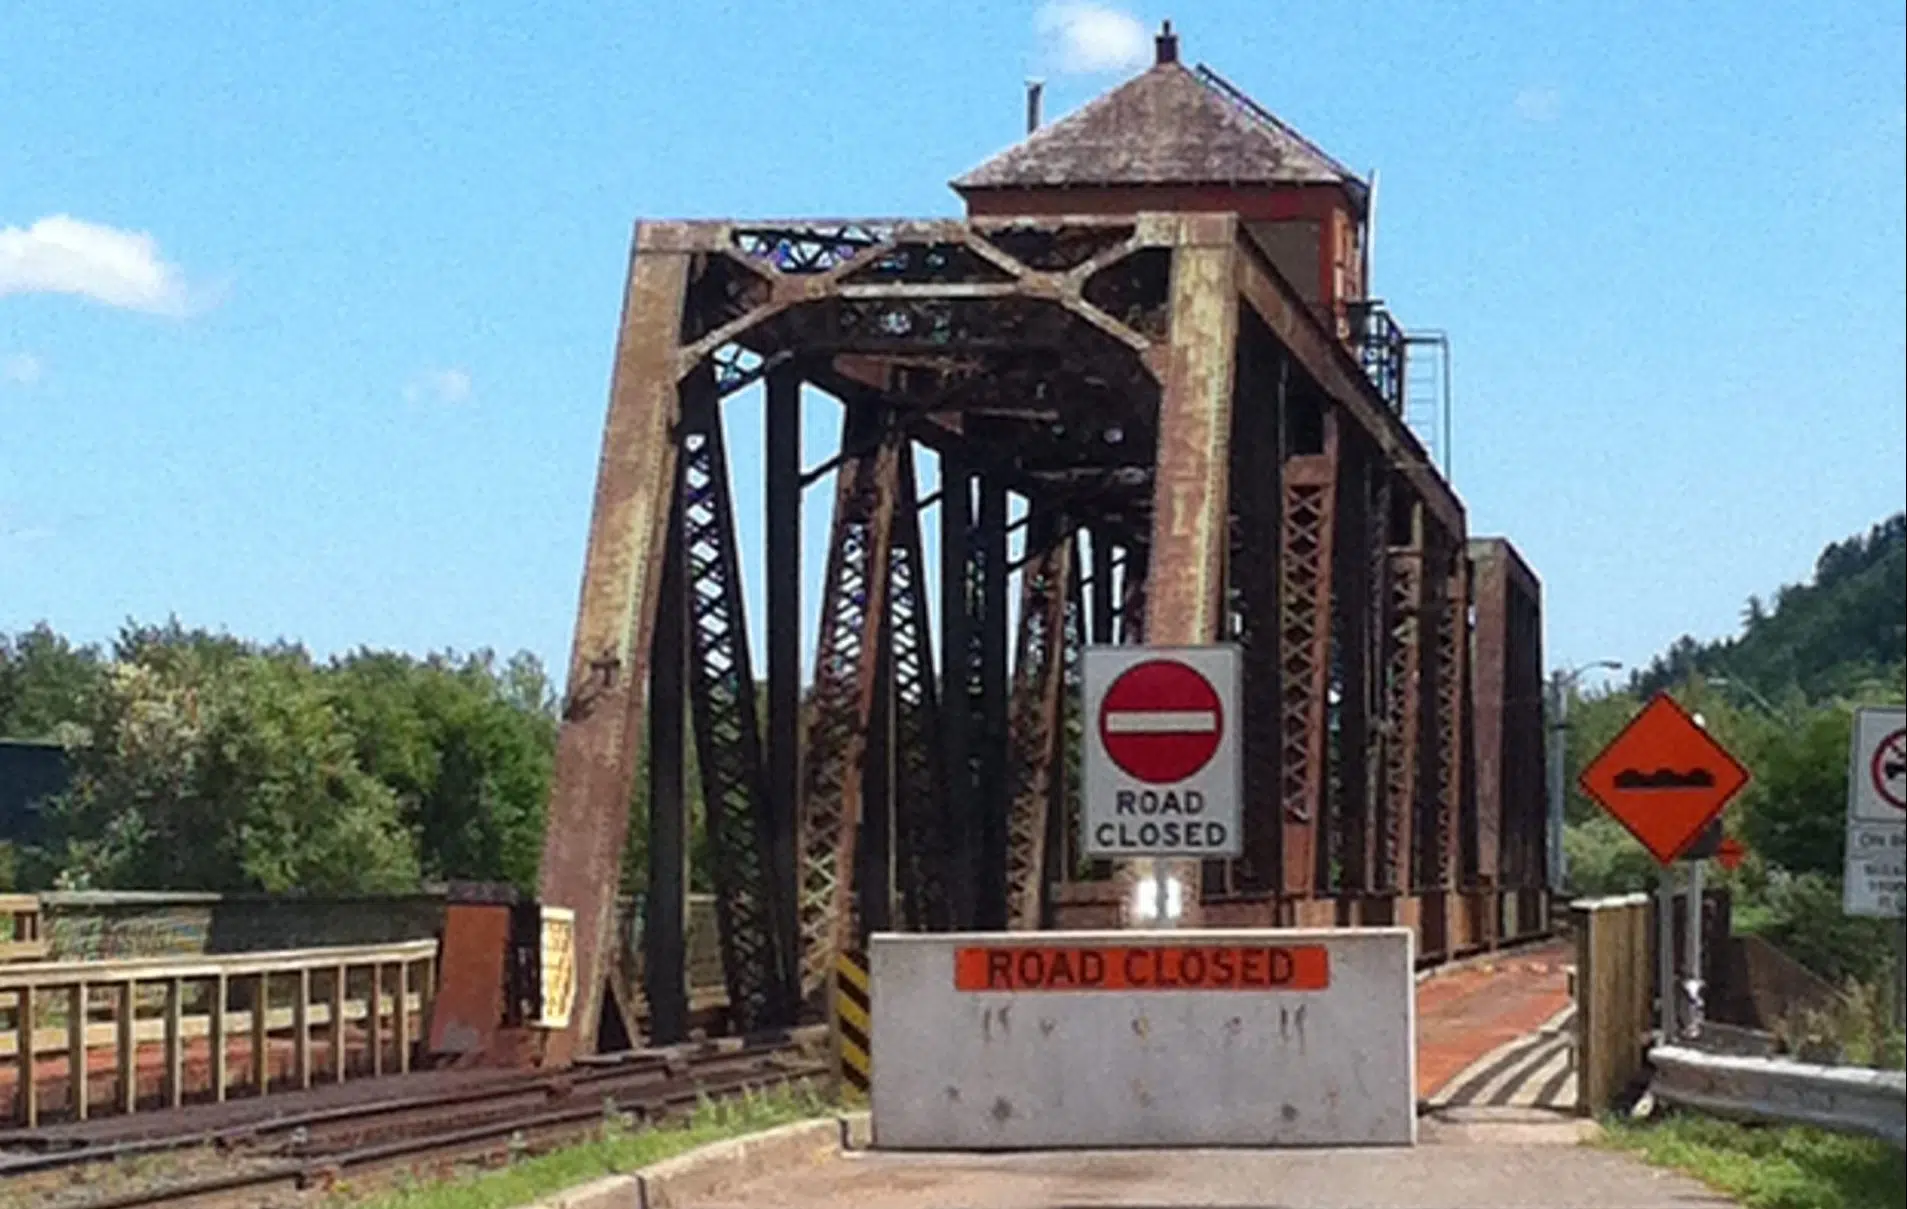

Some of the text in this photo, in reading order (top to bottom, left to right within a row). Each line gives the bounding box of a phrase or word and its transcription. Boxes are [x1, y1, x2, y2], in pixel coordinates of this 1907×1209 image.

[1116, 789, 1204, 815] ROAD
[1095, 822, 1228, 848] CLOSED
[986, 947, 1295, 989] ROAD CLOSED
